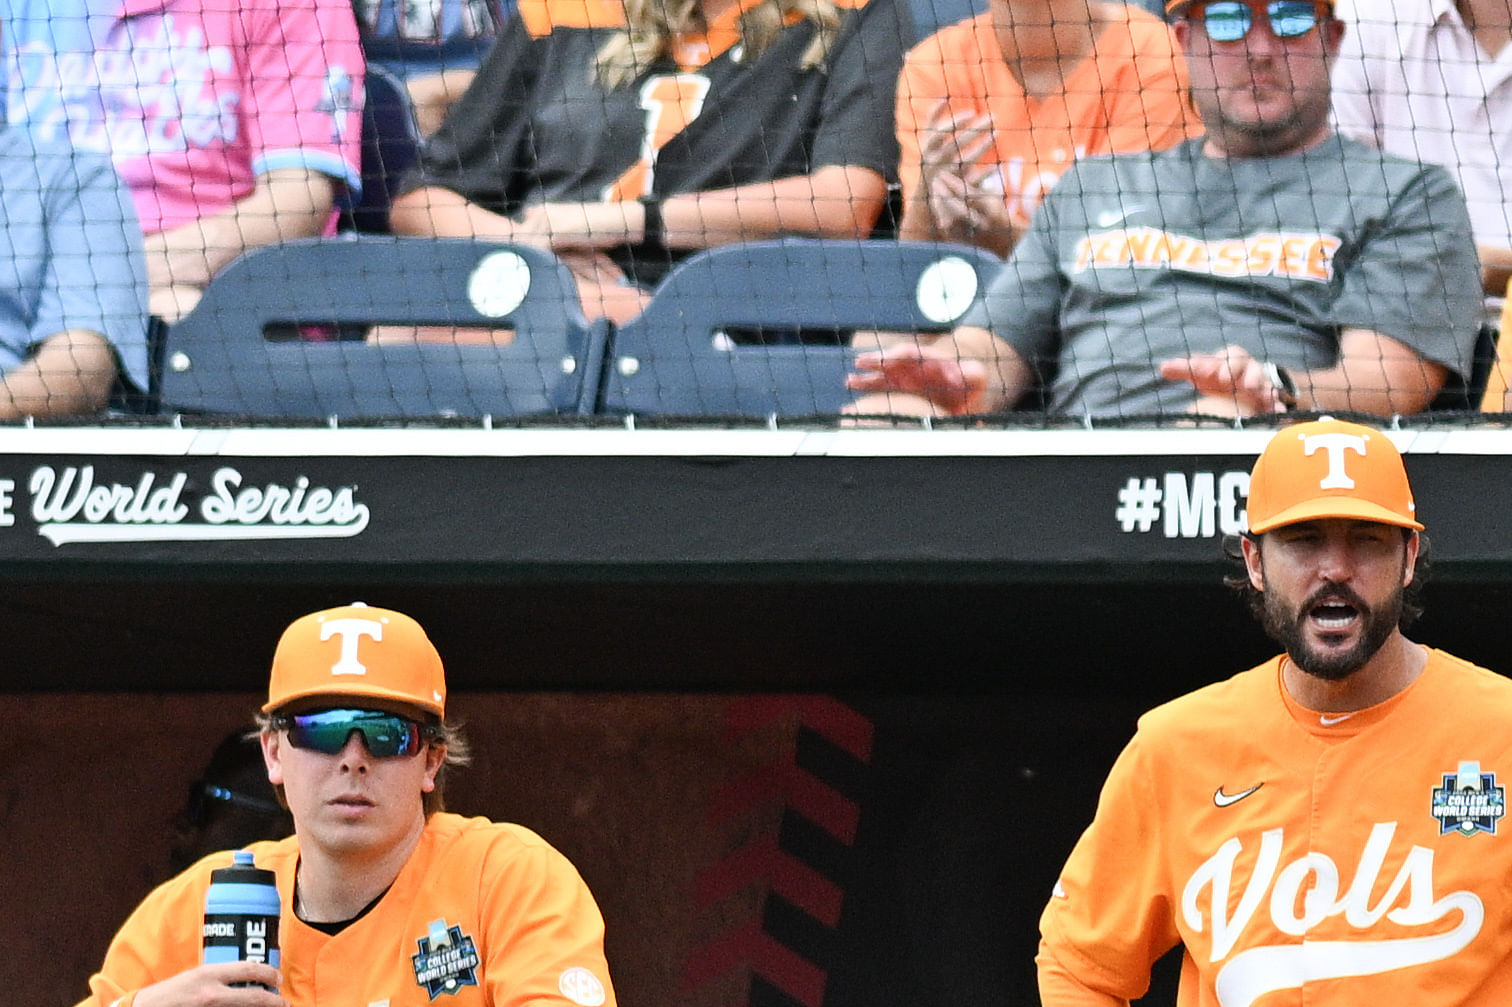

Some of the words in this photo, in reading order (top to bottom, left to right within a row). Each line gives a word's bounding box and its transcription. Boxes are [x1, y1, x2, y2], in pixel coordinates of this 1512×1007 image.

[1074, 226, 1342, 284] TENNESSEE
[1303, 432, 1367, 490] T
[0, 479, 15, 527] E
[30, 466, 189, 523] World
[202, 468, 362, 525] Series
[320, 618, 383, 675] T
[1433, 805, 1468, 817] WORLD
[1468, 805, 1502, 816] SERIES
[1182, 821, 1474, 962] Vols
[417, 964, 448, 984] WORLD
[446, 954, 477, 975] SERIES
